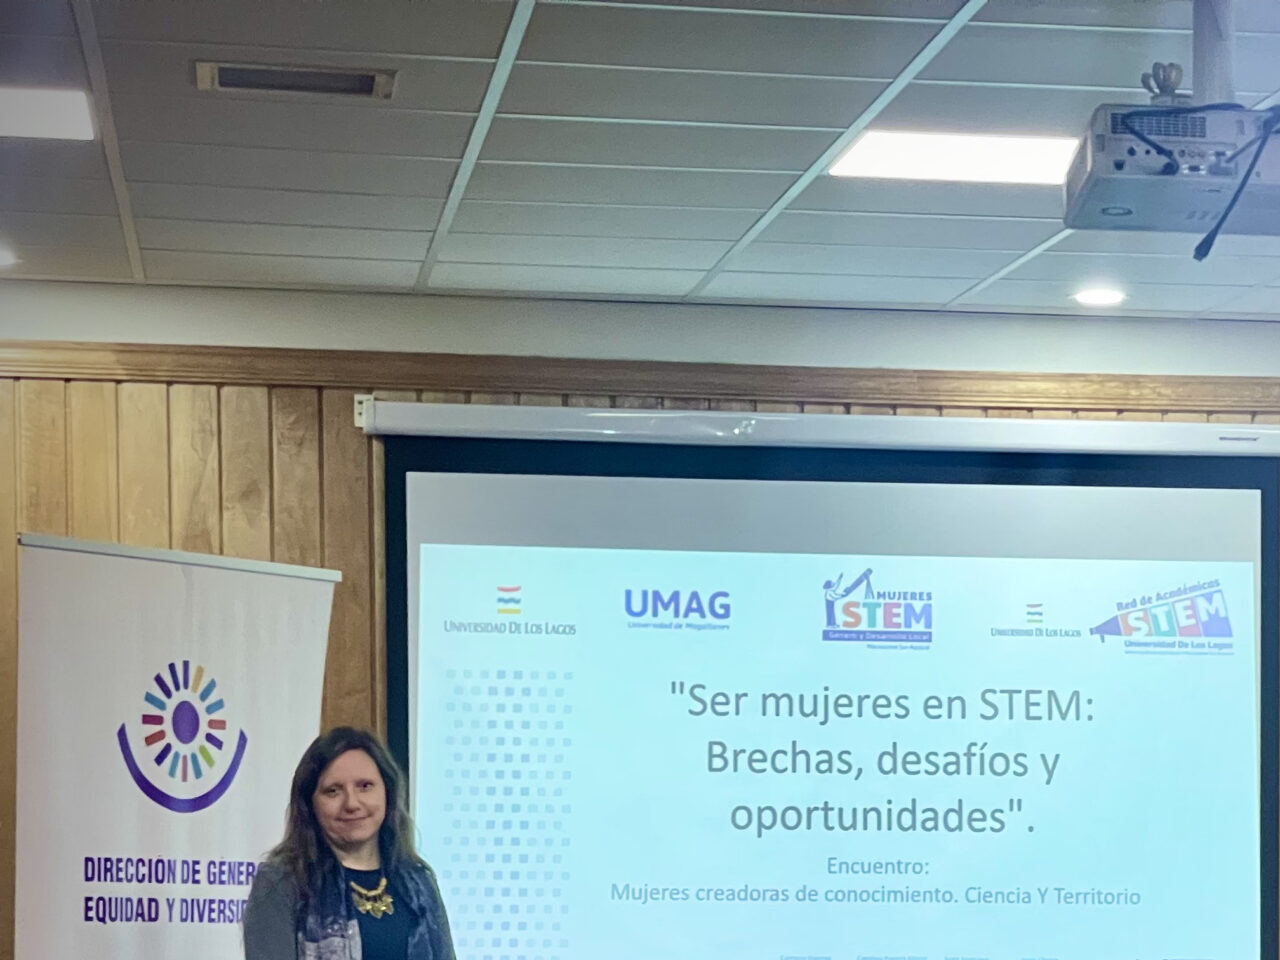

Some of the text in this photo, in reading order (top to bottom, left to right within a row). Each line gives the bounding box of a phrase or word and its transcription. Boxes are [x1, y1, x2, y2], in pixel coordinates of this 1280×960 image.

[624, 589, 731, 619] UMAG
[876, 592, 932, 601] MUJERES
[1116, 598, 1138, 612] Red
[443, 620, 507, 634] UNIVERSIDAD
[524, 622, 543, 635] LOS
[545, 622, 577, 636] LAGOS
[842, 600, 932, 630] STEM
[1126, 590, 1227, 638] STEM
[670, 681, 1095, 727] "Ser mujeres en STEM:
[706, 740, 1061, 785] Brechas, desafíos y
[730, 798, 1035, 838] oportunidades".
[180, 859, 202, 884] DE
[827, 856, 930, 876] Encuentro:
[611, 883, 1142, 906] Mujeres creadoras de conocimiento. Ciencia Y Territorio
[83, 896, 160, 924] EQUIDAD
[166, 897, 176, 922] Y
